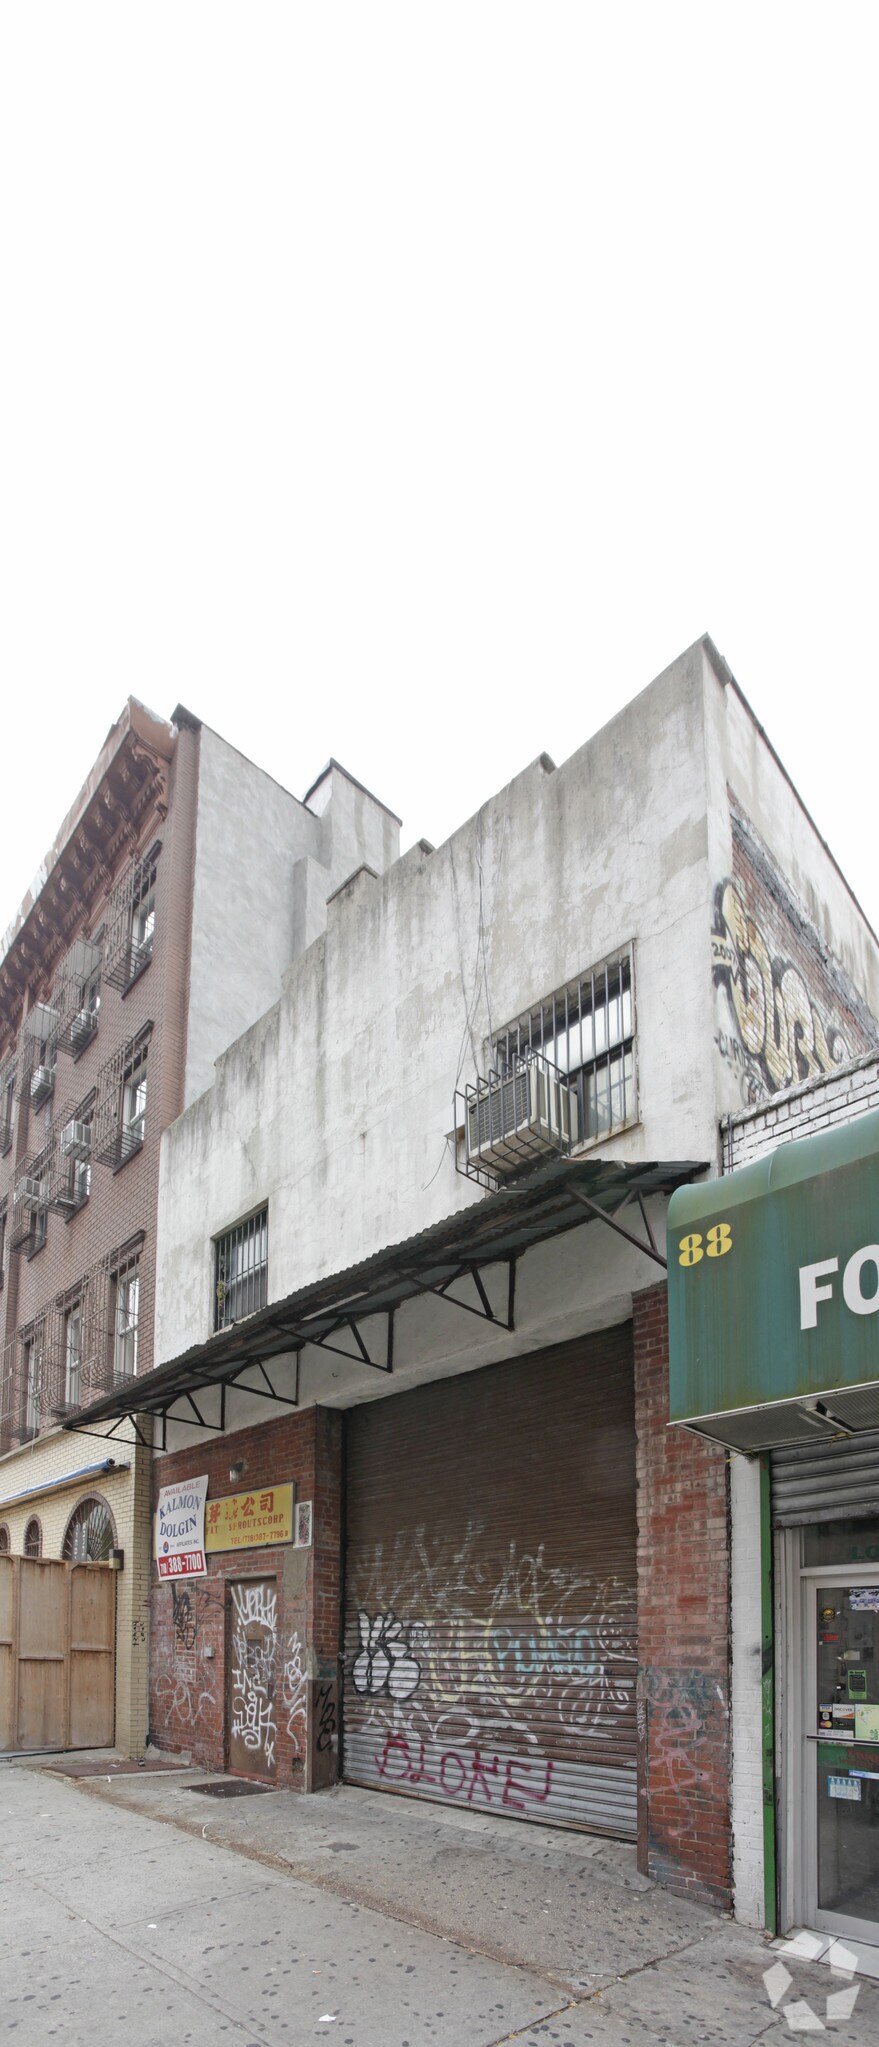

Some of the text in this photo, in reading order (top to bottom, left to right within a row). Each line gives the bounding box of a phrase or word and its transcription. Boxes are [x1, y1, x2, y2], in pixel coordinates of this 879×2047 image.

[678, 1223, 733, 1267] 88
[798, 1244, 879, 1331] FO
[164, 1480, 201, 1497] AVAILABLE
[159, 1494, 202, 1521] KALMON
[159, 1514, 198, 1538] DOLGIN
[168, 1552, 203, 1574] 388-7700
